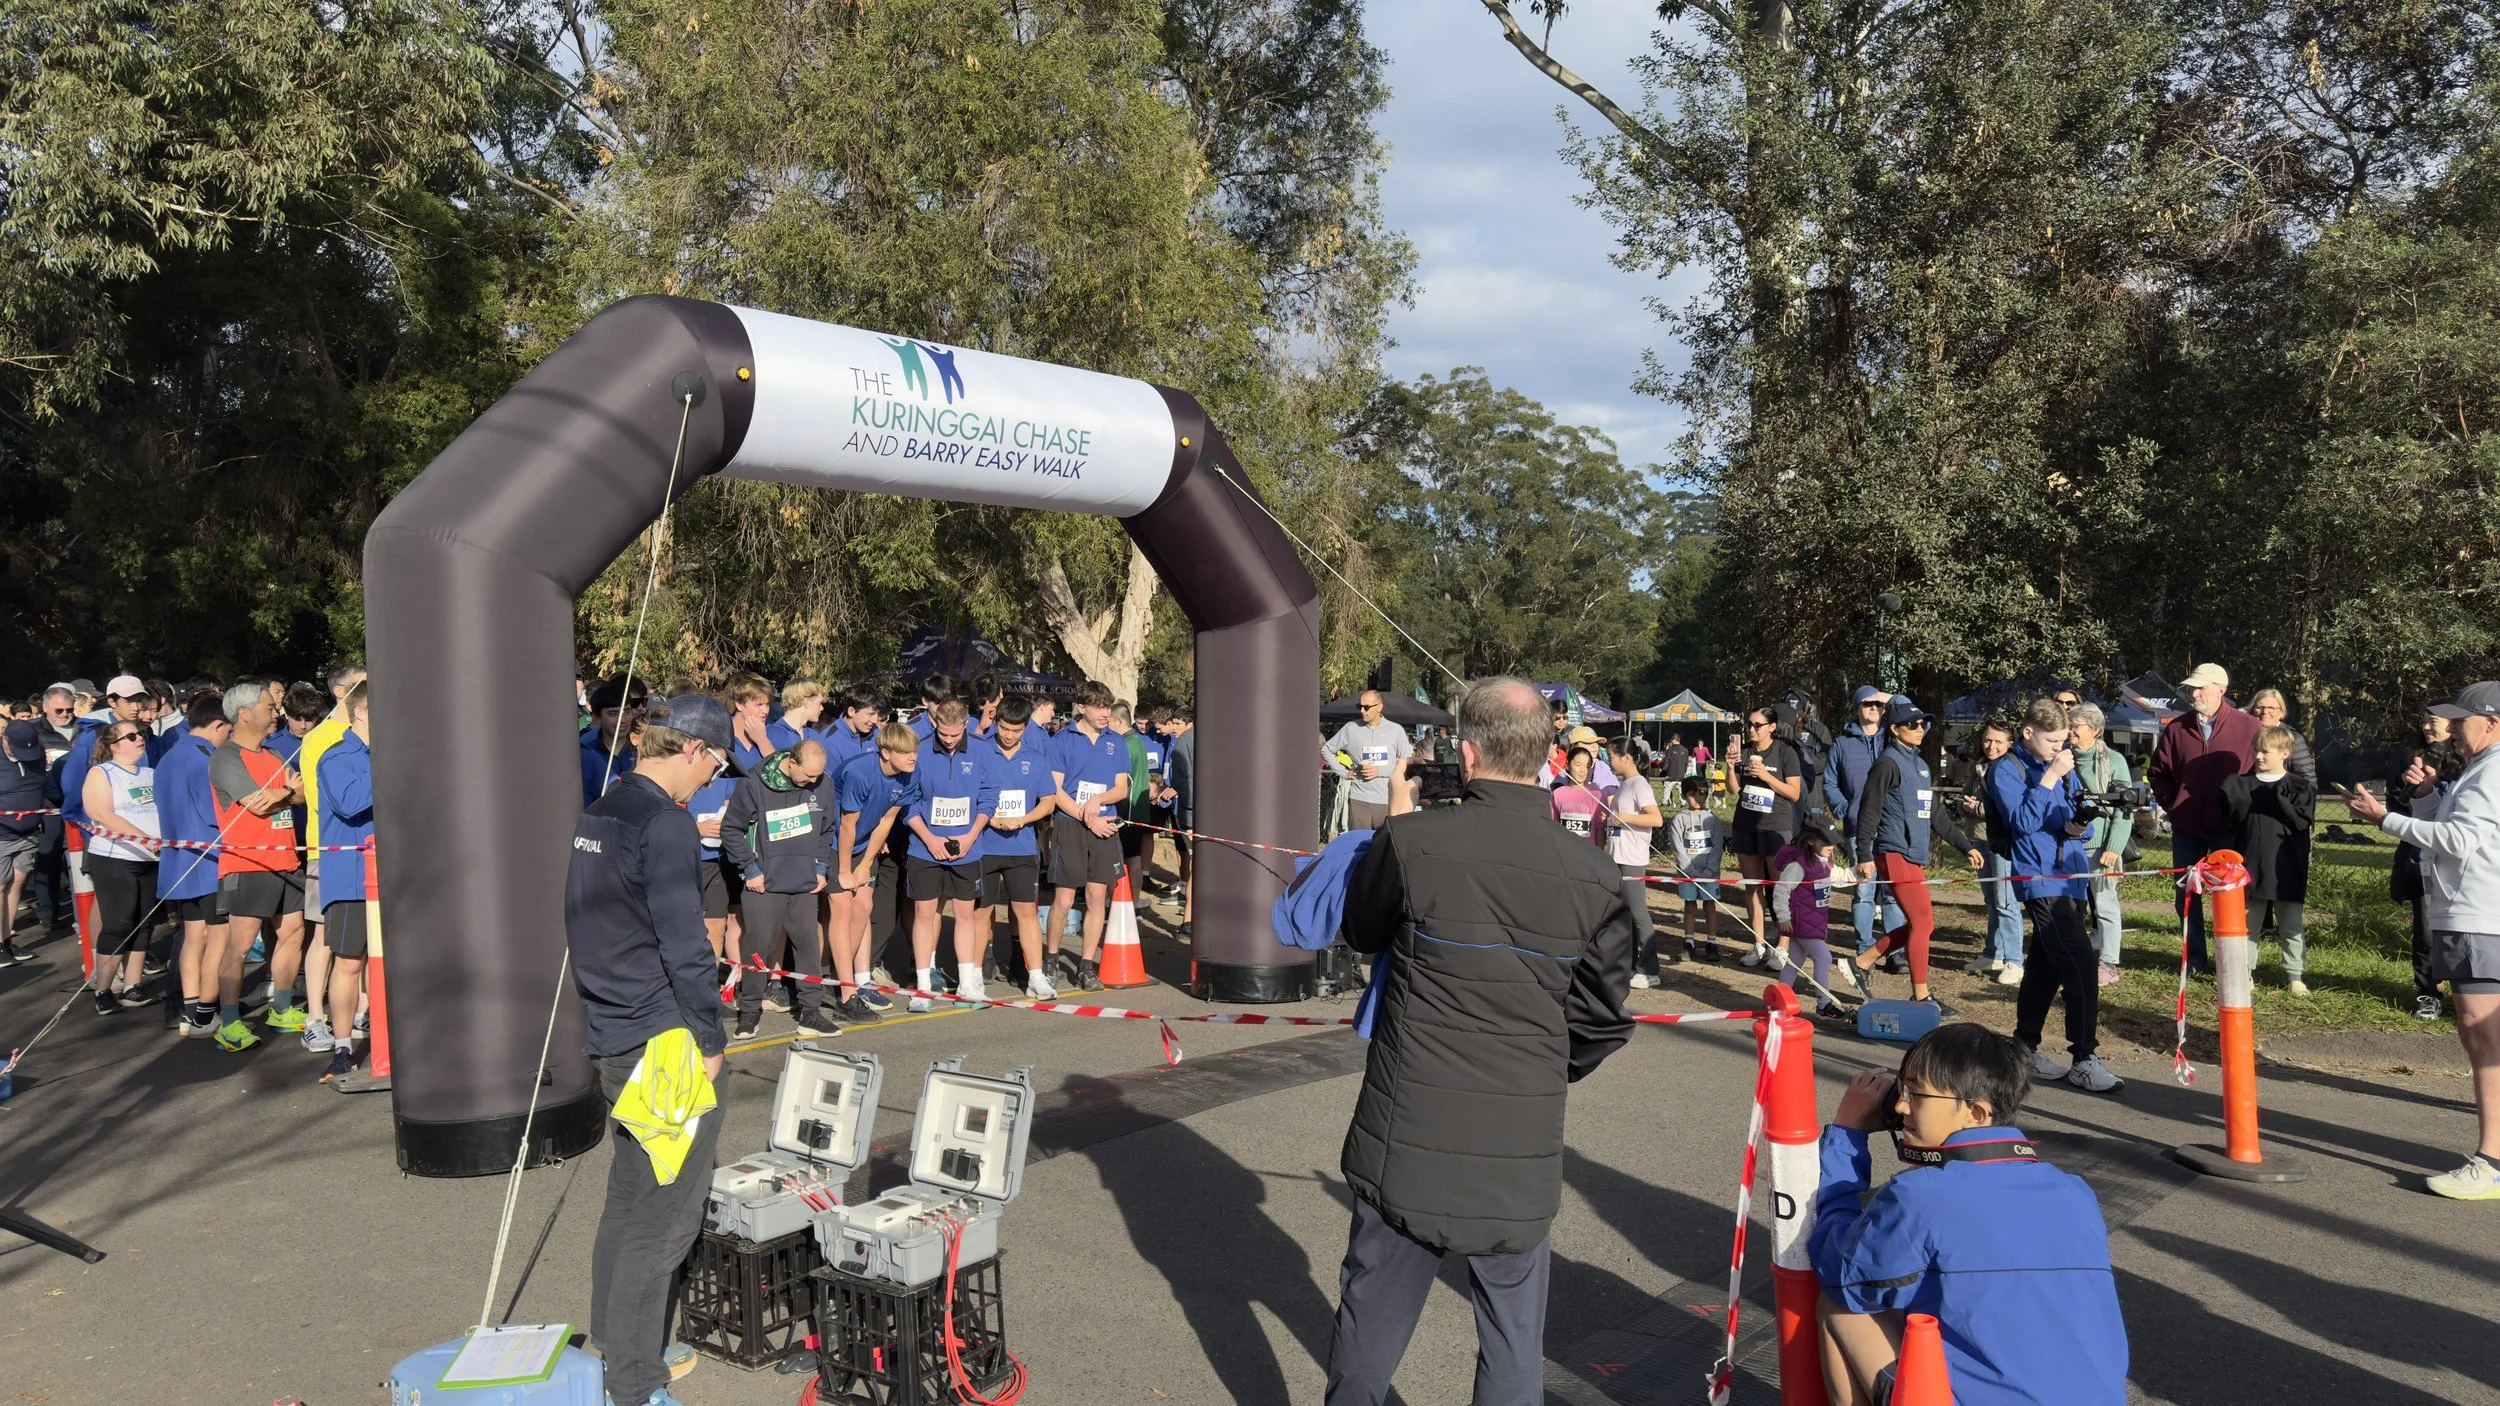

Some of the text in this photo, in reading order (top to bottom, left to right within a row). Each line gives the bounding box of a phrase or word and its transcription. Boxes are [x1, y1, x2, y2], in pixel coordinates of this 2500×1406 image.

[849, 367, 893, 396] THE
[851, 395, 1091, 456] KURINGGAI CHASE
[842, 431, 1086, 479] AND BARRY EASY WALK
[1003, 683, 1047, 694] RAMMAR
[1368, 753, 1382, 761] 549
[998, 799, 1022, 810] UDDY
[1747, 794, 1765, 805] 548
[935, 807, 967, 818] BUDDY
[779, 816, 801, 831] 268
[1565, 820, 1584, 831] 852
[1689, 840, 1706, 849] 554
[1904, 1148, 1942, 1162] EOS 90D
